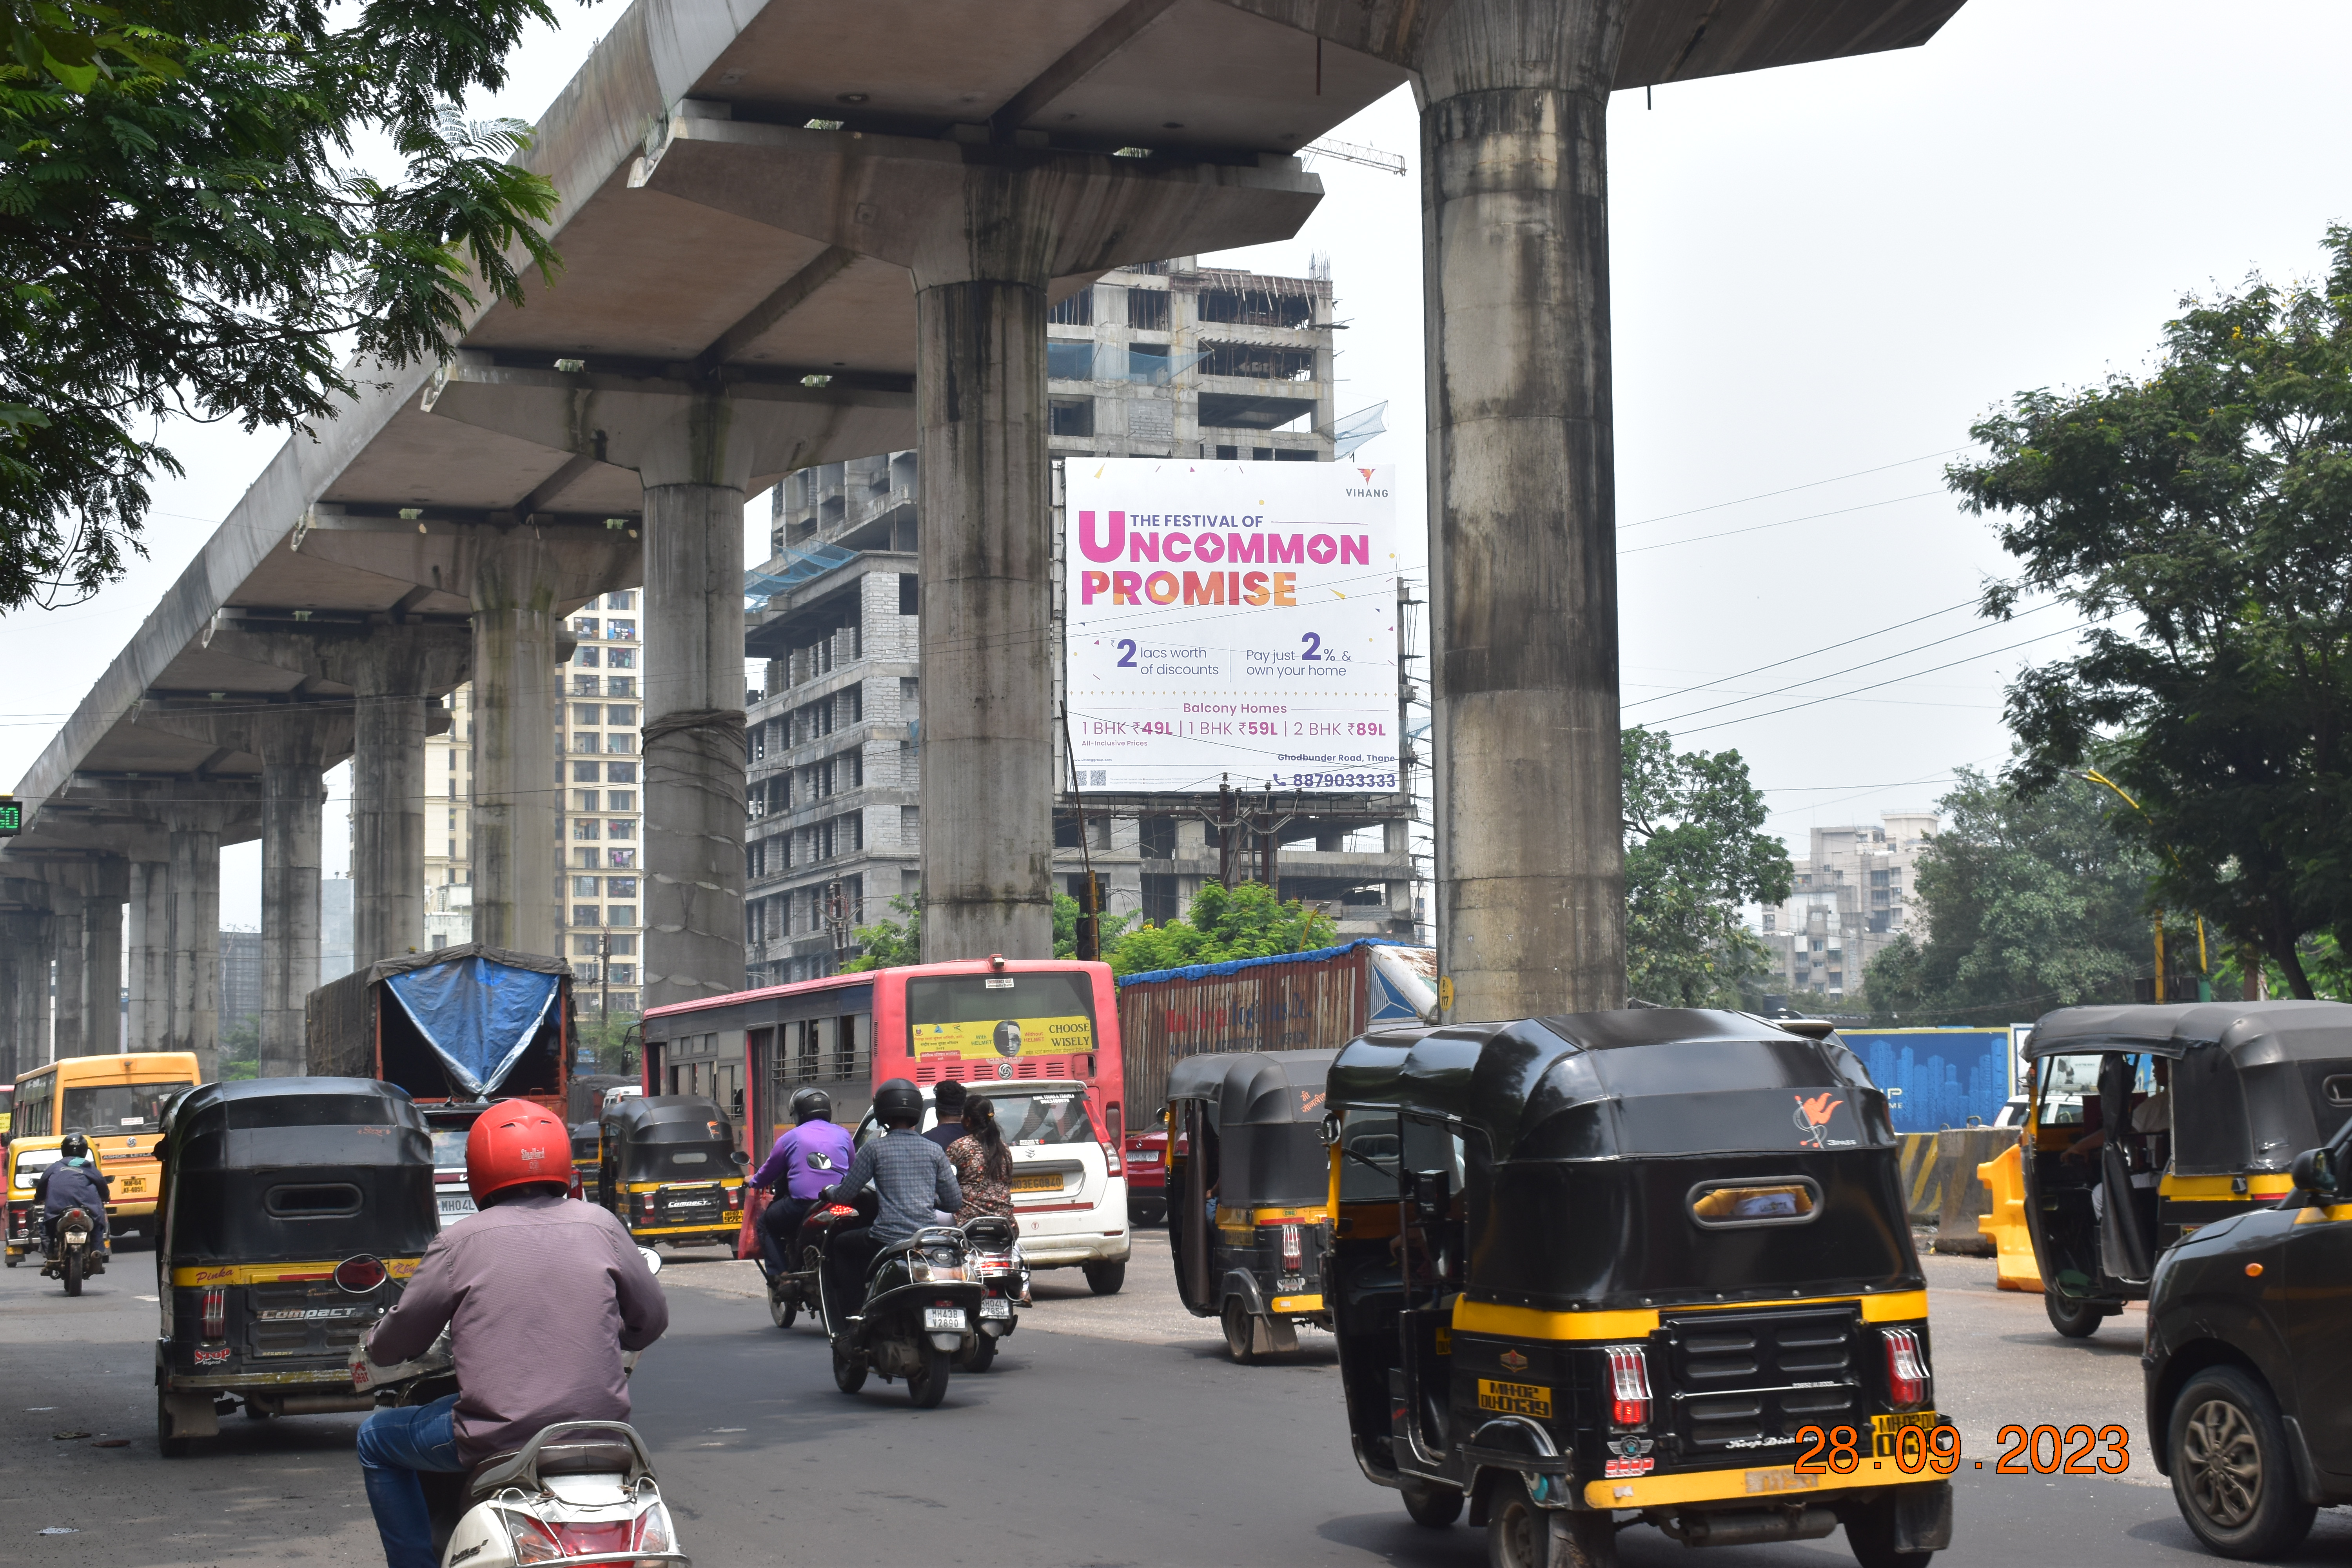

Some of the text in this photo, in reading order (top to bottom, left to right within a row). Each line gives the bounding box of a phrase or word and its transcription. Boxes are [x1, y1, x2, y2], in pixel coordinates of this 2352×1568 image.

[1346, 488, 1388, 498] VIHANG
[1131, 515, 1263, 528] THE FESTIVAL OF
[1079, 511, 1369, 565] UNCOMMON
[1082, 570, 1296, 606] PROMISE
[1141, 647, 1207, 659] lacs worth
[1246, 650, 1270, 664] Pay
[1272, 650, 1295, 664] just
[1342, 650, 1351, 661] &
[1141, 663, 1219, 675] of discounts
[1246, 665, 1347, 679] own your home
[1183, 702, 1287, 717] Balcony Homes
[1082, 722, 1087, 735] 1
[1093, 722, 1127, 735] BHK
[1189, 722, 1194, 735] 1
[1200, 722, 1232, 735] BHK
[1294, 722, 1303, 735] 2
[1309, 722, 1341, 736] BHK
[1338, 754, 1364, 763] Road,
[1293, 773, 1396, 788] 8879033333
[1049, 1023, 1090, 1033] CHOOSE
[1051, 1036, 1090, 1047] WISELY
[1011, 1177, 1061, 1190] H03EG0840
[932, 1310, 958, 1318] MH43B
[195, 1348, 230, 1365] STOP
